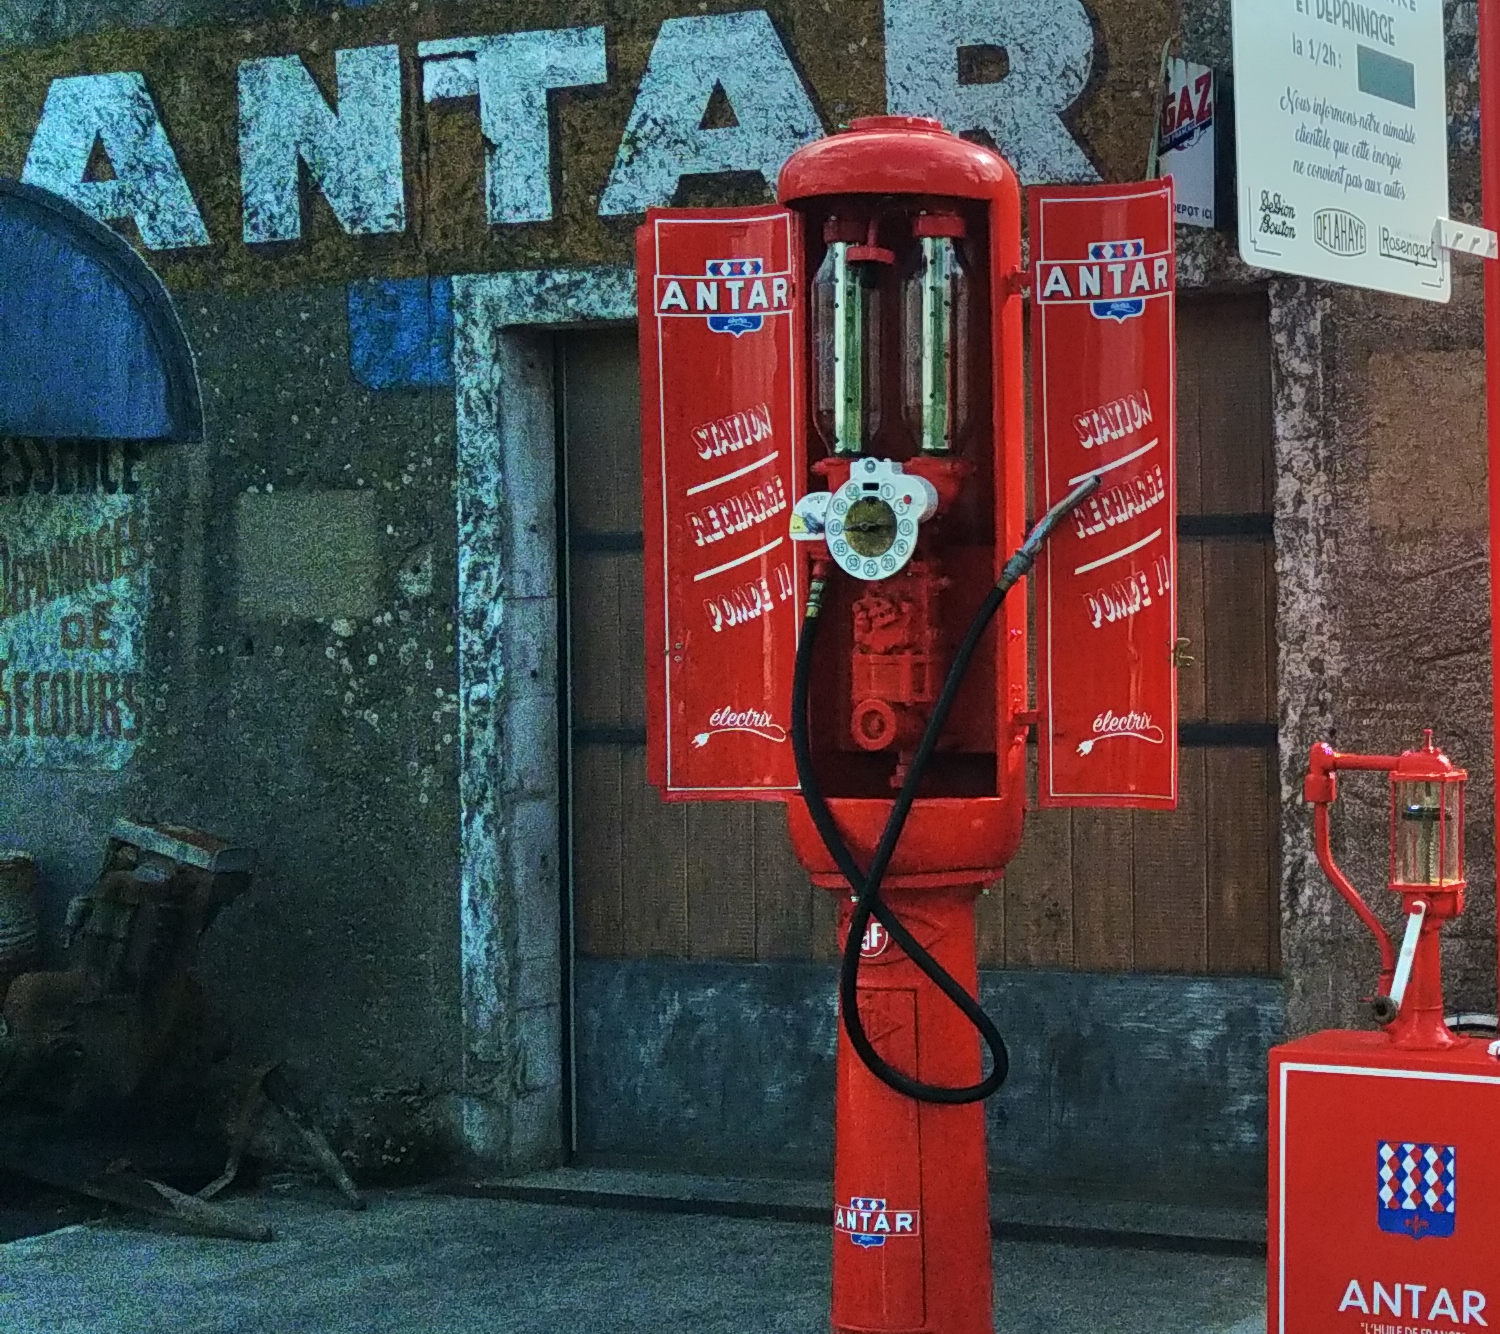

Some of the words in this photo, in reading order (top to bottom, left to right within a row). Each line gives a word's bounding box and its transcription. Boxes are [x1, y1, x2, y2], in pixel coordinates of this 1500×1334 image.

[1280, 86, 1311, 115] Nous
[1382, 120, 1416, 144] aimable
[1333, 138, 1350, 159] que
[1352, 139, 1370, 161] cette
[1292, 158, 1305, 175] ne
[1307, 164, 1347, 185] convient
[1345, 174, 1363, 193] pas
[1364, 177, 1382, 194] aux
[1259, 214, 1296, 239] Bouton
[1315, 213, 1366, 252] DELAHAYE
[660, 276, 790, 313] ANTAR
[1043, 256, 1170, 298] ANTAR
[691, 402, 775, 460] STATION
[1073, 389, 1155, 450] STATION
[685, 475, 788, 549] RECHARGE
[1070, 464, 1165, 539] RECHARGE
[703, 579, 775, 634] POMPE
[1082, 572, 1152, 630] POMPE
[709, 707, 774, 729] électrix
[1092, 710, 1153, 734] électrix
[836, 1208, 913, 1233] ANTAR
[1338, 1279, 1489, 1327] ANTAR
